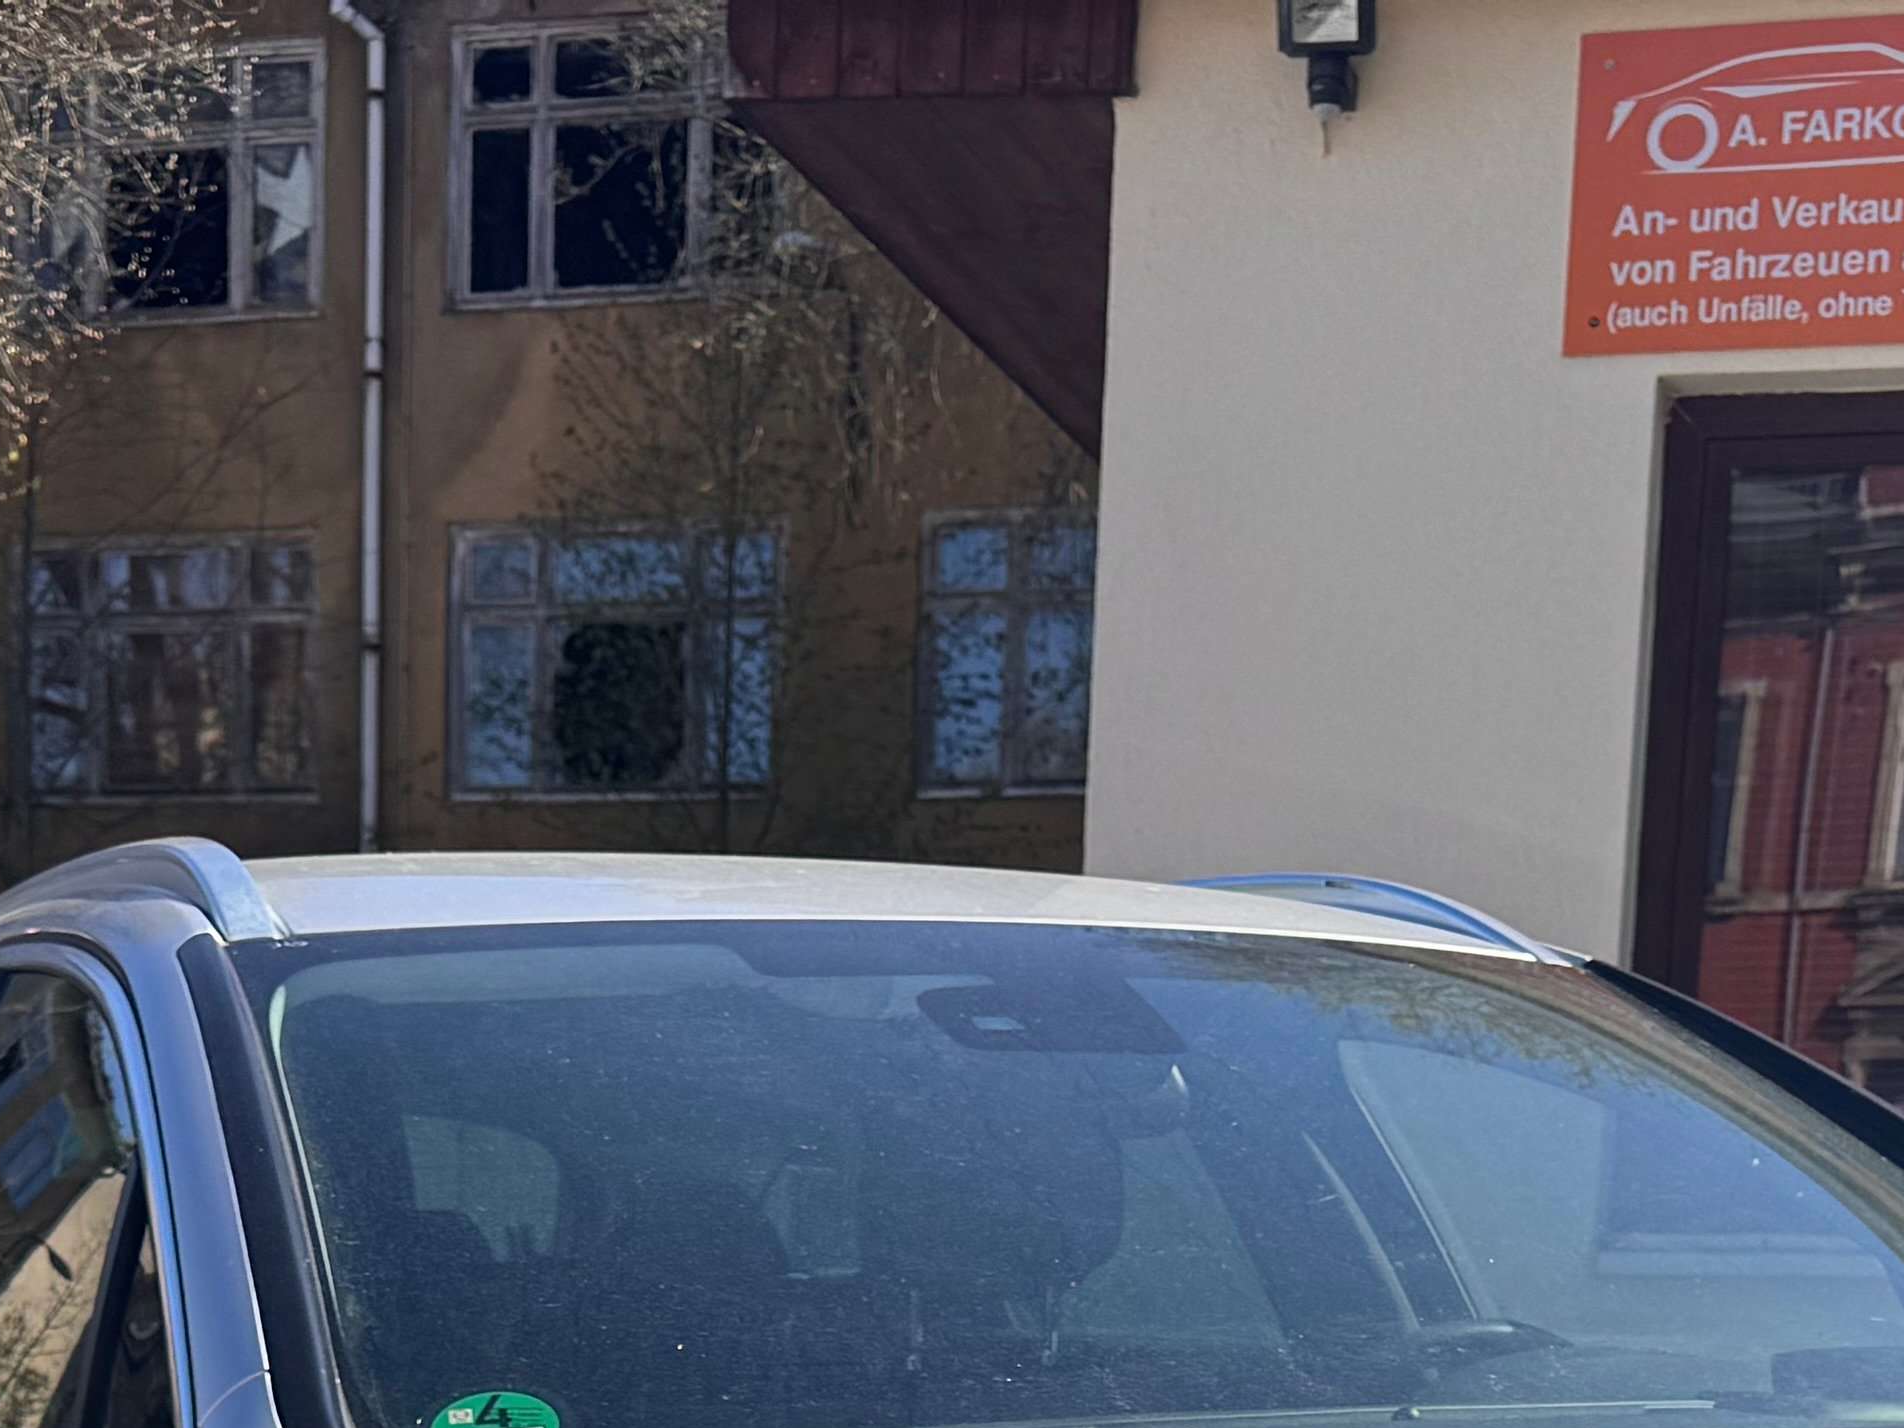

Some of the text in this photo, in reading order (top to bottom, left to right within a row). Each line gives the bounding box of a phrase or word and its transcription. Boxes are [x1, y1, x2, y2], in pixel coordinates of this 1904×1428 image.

[1728, 113, 1767, 148] A.
[1611, 204, 1678, 237] An-
[1689, 198, 1759, 233] und
[1610, 259, 1676, 286] von
[1688, 243, 1890, 282] Fahrzeuen
[1606, 301, 1689, 334] (auch
[1698, 293, 1810, 325] Unfälle,
[1818, 293, 1893, 320] ohne
[475, 1394, 512, 1428] 4
